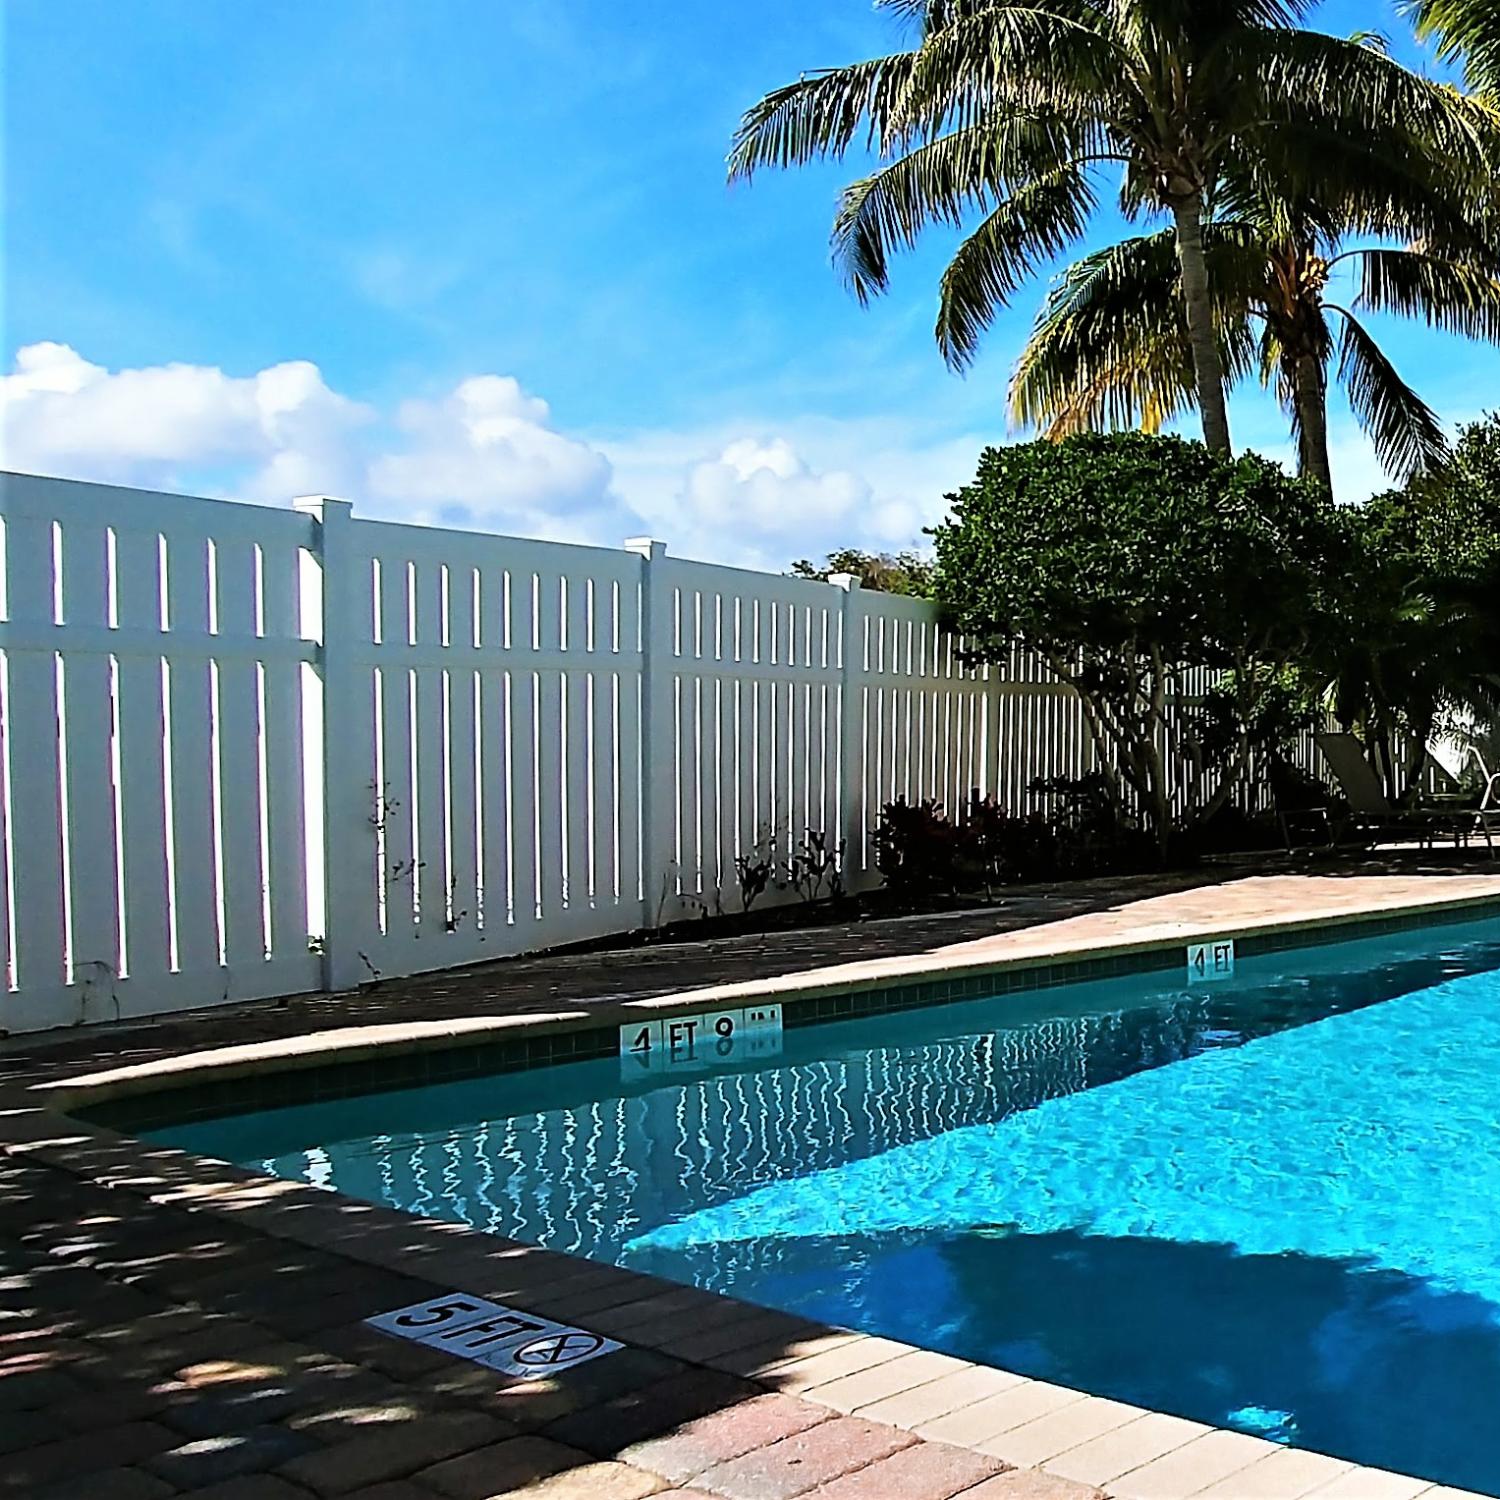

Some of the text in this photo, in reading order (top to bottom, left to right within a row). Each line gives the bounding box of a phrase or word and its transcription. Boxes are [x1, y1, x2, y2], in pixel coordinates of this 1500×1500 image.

[630, 1027, 652, 1052] 4
[669, 1021, 698, 1047] FT
[396, 1302, 545, 1348] 5 FT
